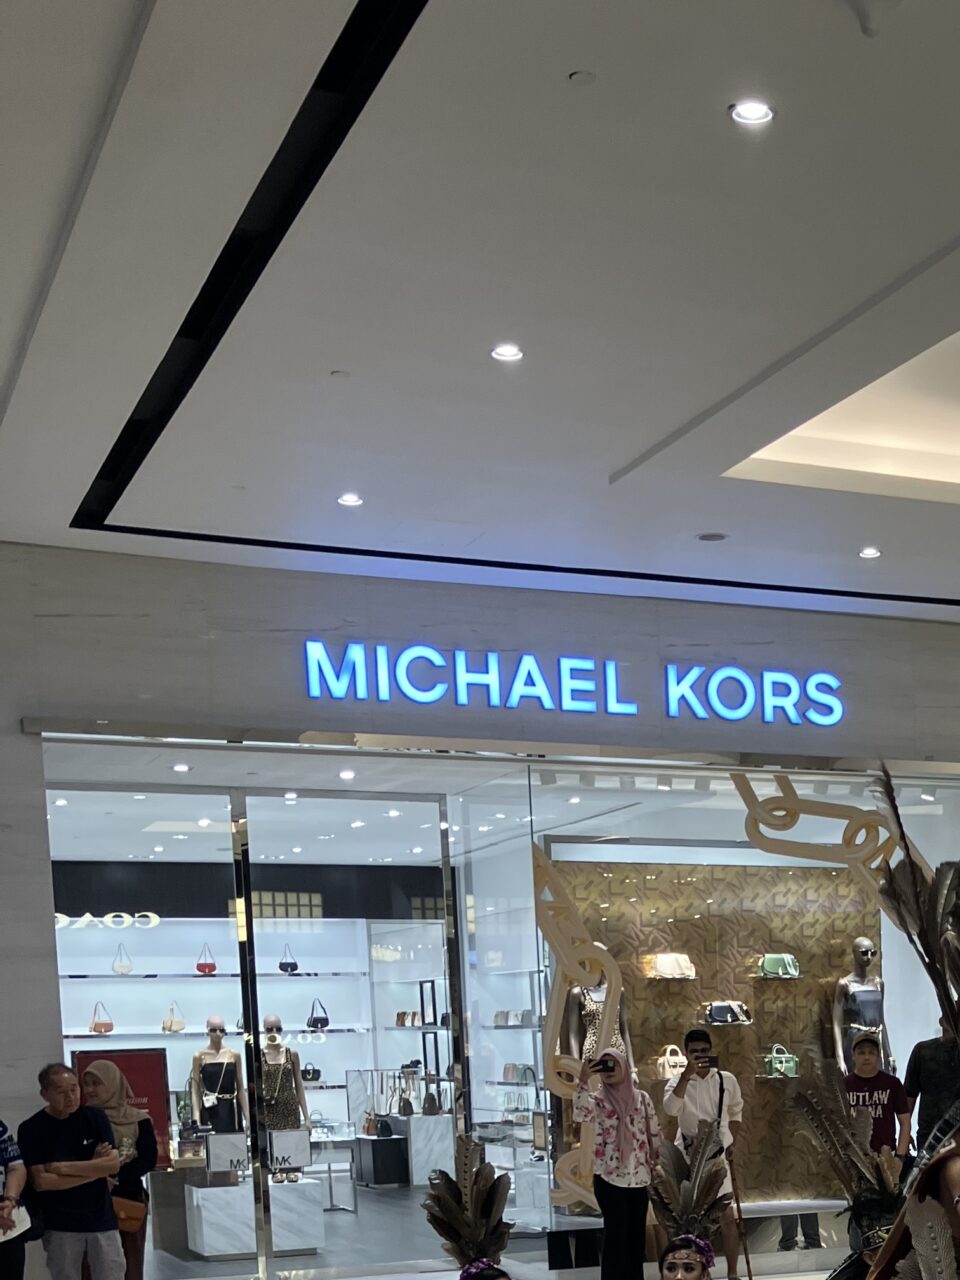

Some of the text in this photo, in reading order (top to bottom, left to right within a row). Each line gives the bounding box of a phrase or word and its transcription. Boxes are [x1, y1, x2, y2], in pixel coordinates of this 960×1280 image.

[305, 639, 845, 726] MICHAEL KORS
[846, 1089, 890, 1105] UTLAW
[229, 1159, 246, 1169] MK
[275, 1156, 291, 1166] MK
